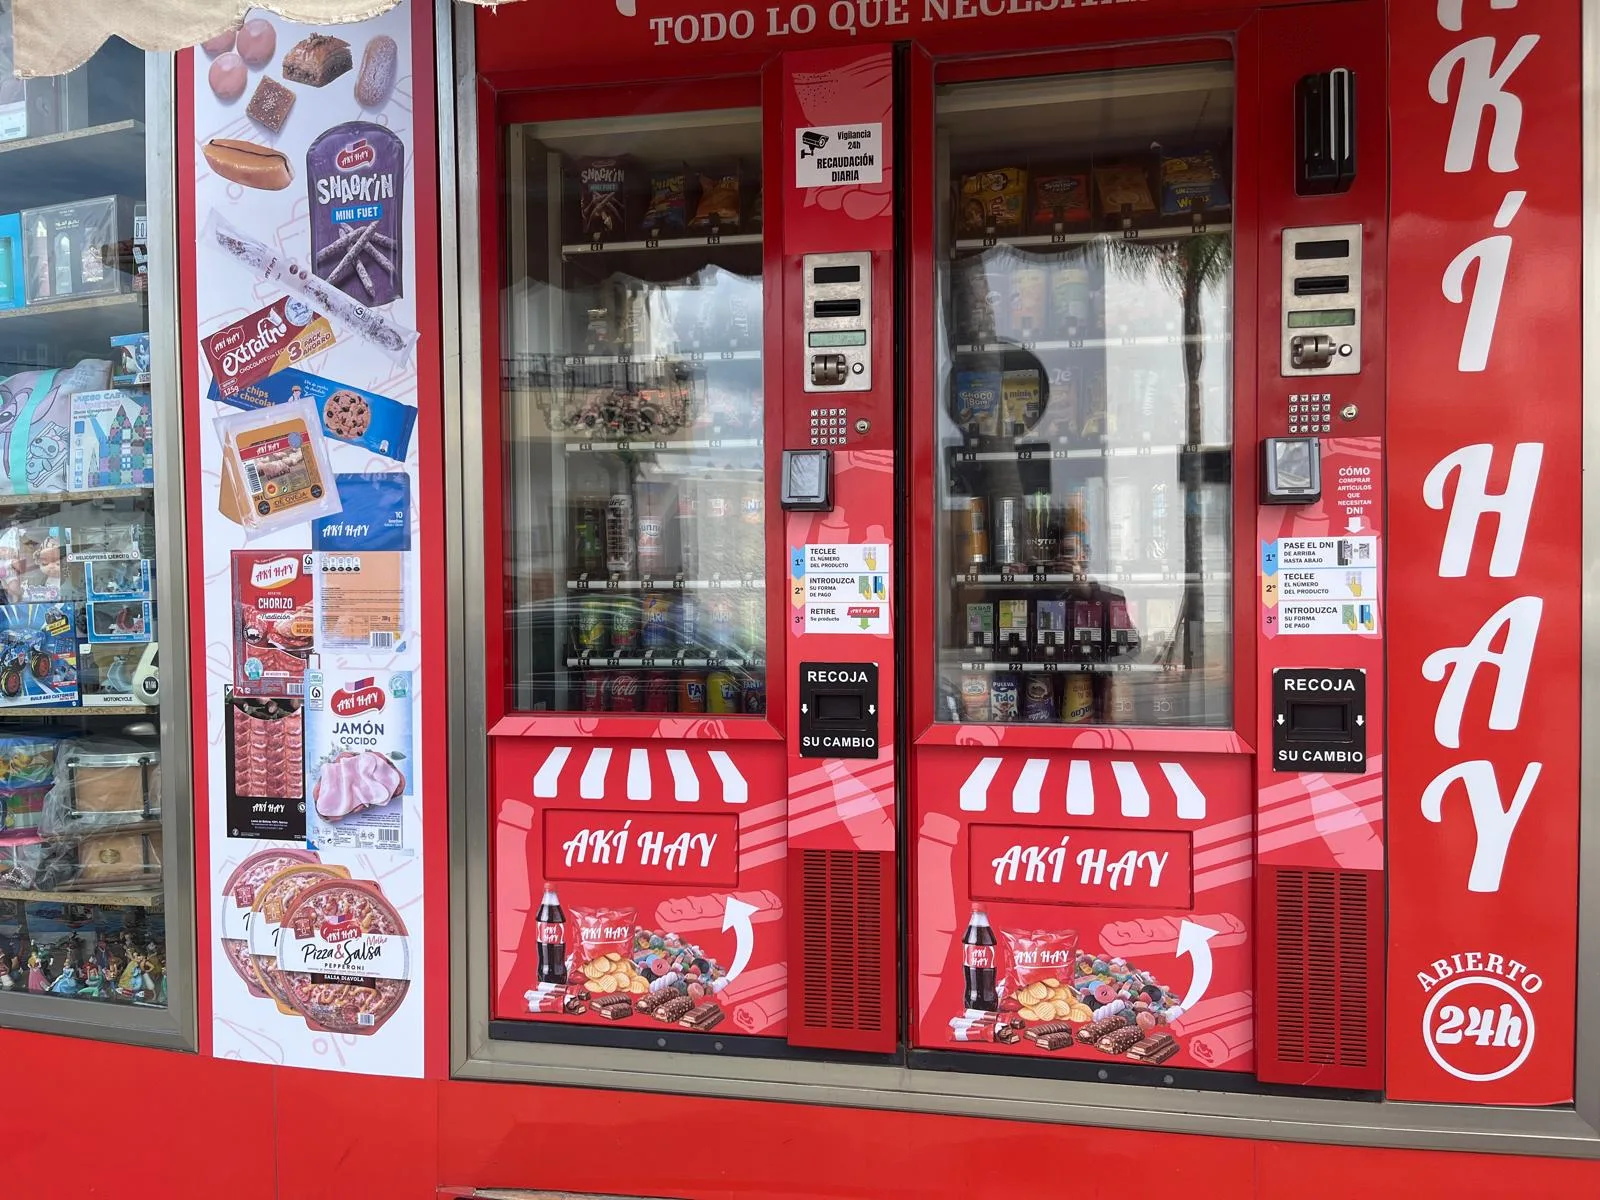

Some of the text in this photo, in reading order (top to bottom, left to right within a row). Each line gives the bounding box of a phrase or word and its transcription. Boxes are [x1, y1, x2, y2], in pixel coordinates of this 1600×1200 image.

[650, 9, 755, 46] TODO
[766, 5, 816, 37] LO
[840, 0, 910, 36] QUE
[837, 130, 871, 140] Vigilancia
[847, 141, 861, 150] 24h
[817, 153, 874, 169] RECAUDACIÓN
[831, 170, 859, 182] DIARIA
[335, 206, 379, 221] MINI FUET
[303, 333, 331, 356] AHORRO
[304, 332, 321, 346] PACK
[287, 340, 304, 363] 3
[240, 356, 267, 374] CHOCOLATE
[223, 385, 239, 396] 125g
[246, 385, 269, 398] chips
[960, 391, 993, 400] CHOCO
[1338, 466, 1370, 476] CÓMO
[394, 511, 403, 519] 10
[1346, 507, 1364, 515] DNI
[322, 520, 344, 537] AKÍ
[345, 524, 370, 538] HAY
[256, 563, 294, 582] AKÍ HAY
[258, 597, 293, 609] CHORIZO
[1420, 443, 1544, 893] HAY
[807, 671, 868, 682] RECOJA
[1284, 679, 1356, 691] RECOJA
[337, 691, 378, 713] AKÍ HAY
[993, 693, 1015, 703] Tido
[332, 720, 384, 735] JAMÓN
[340, 736, 377, 745] COCIDO
[803, 736, 875, 748] SU CAMBIO
[1278, 750, 1363, 762] SU CAMBIO
[252, 801, 285, 814] AKÍ HAY
[562, 820, 718, 871] AKÍ HAY
[991, 836, 1169, 890] AKÍ HAY
[341, 928, 358, 941] HAY
[604, 926, 629, 939] HAY
[301, 939, 381, 966] Pizza & Salsa
[1014, 947, 1069, 964] AKÍ HAY
[324, 962, 365, 971] PEPPERONI
[972, 957, 988, 966] HAY
[1416, 952, 1543, 994] ABIERTO
[1435, 1003, 1522, 1048] 24h
